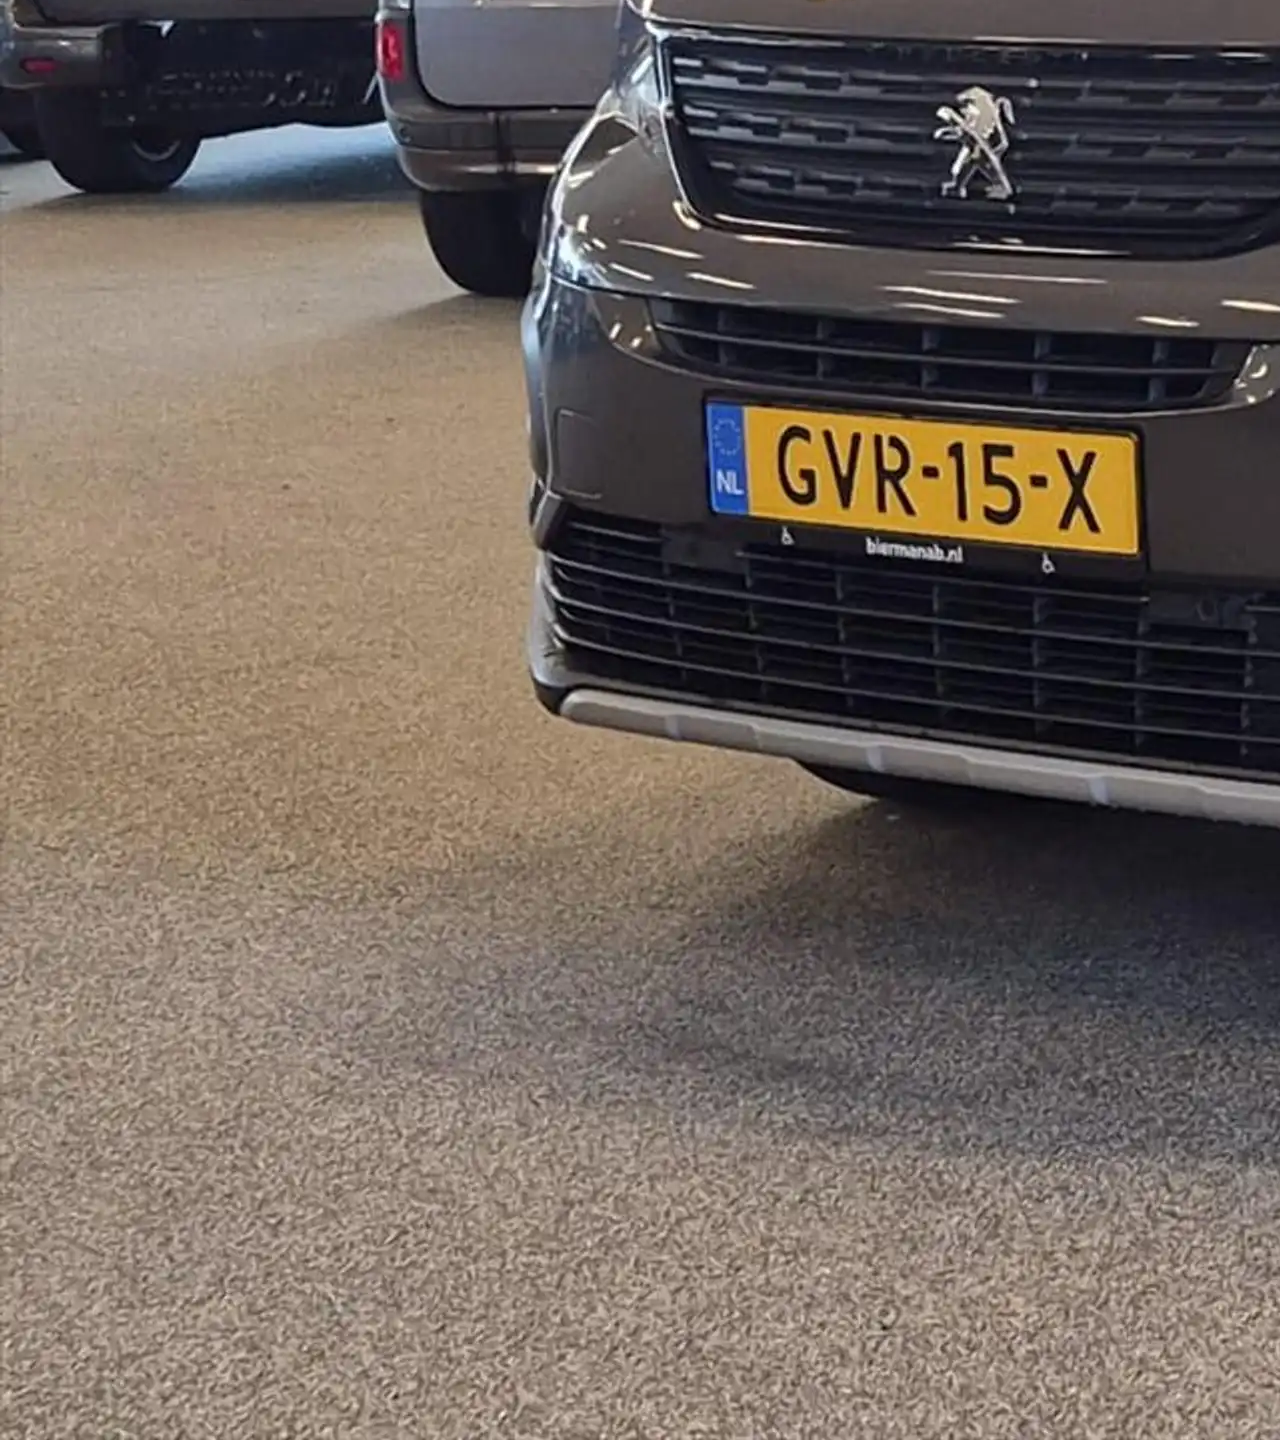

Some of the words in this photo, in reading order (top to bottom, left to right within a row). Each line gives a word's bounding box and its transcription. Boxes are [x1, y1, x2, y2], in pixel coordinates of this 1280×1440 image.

[716, 468, 745, 496] NL
[777, 425, 1101, 534] GVR-15-X
[865, 535, 963, 563] biermanab.nl
